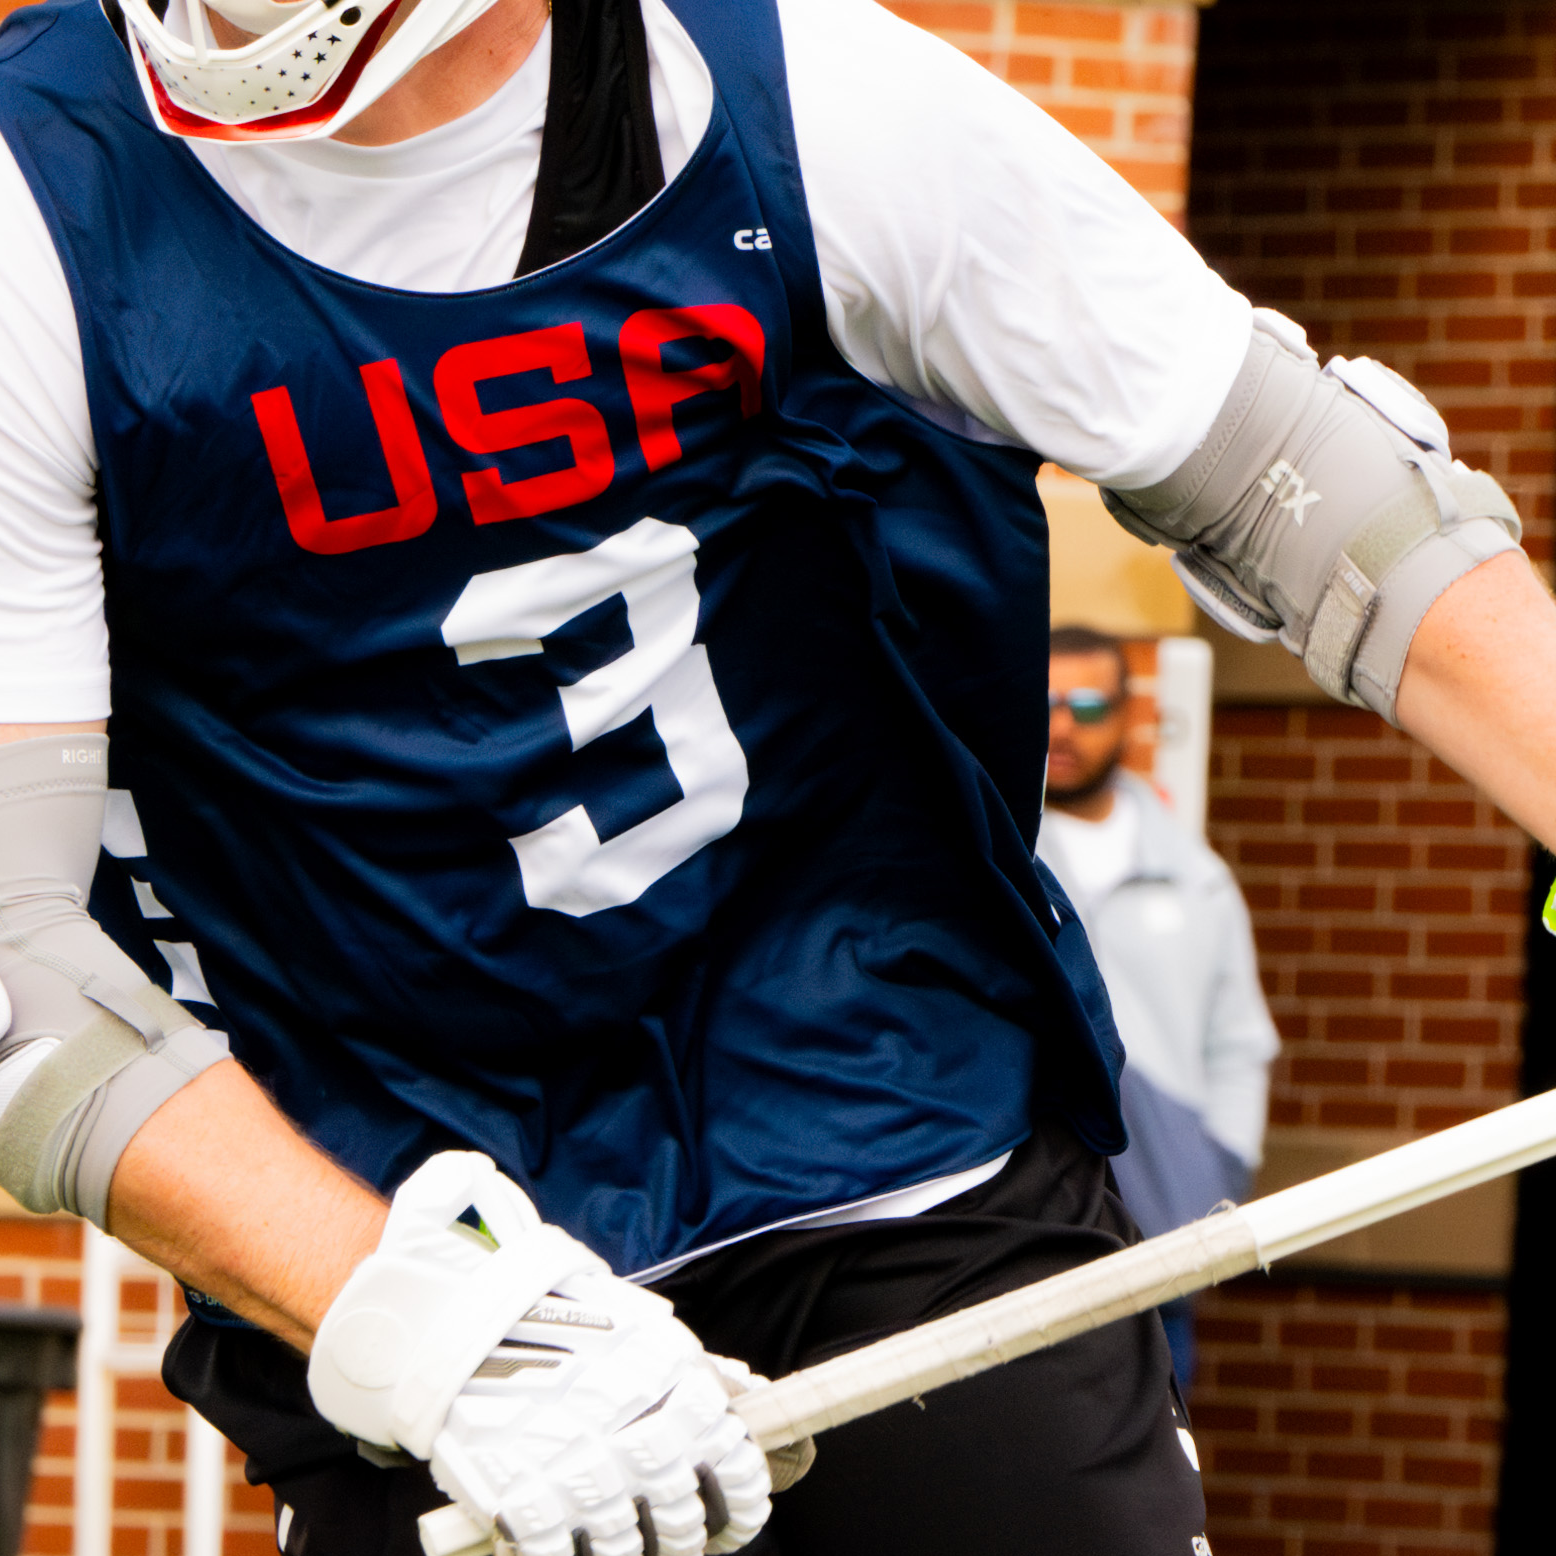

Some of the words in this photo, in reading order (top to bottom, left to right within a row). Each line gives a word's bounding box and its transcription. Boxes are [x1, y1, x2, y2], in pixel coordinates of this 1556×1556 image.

[250, 303, 766, 555] USA
[61, 749, 103, 764] RIGHT
[441, 516, 750, 918] 3
